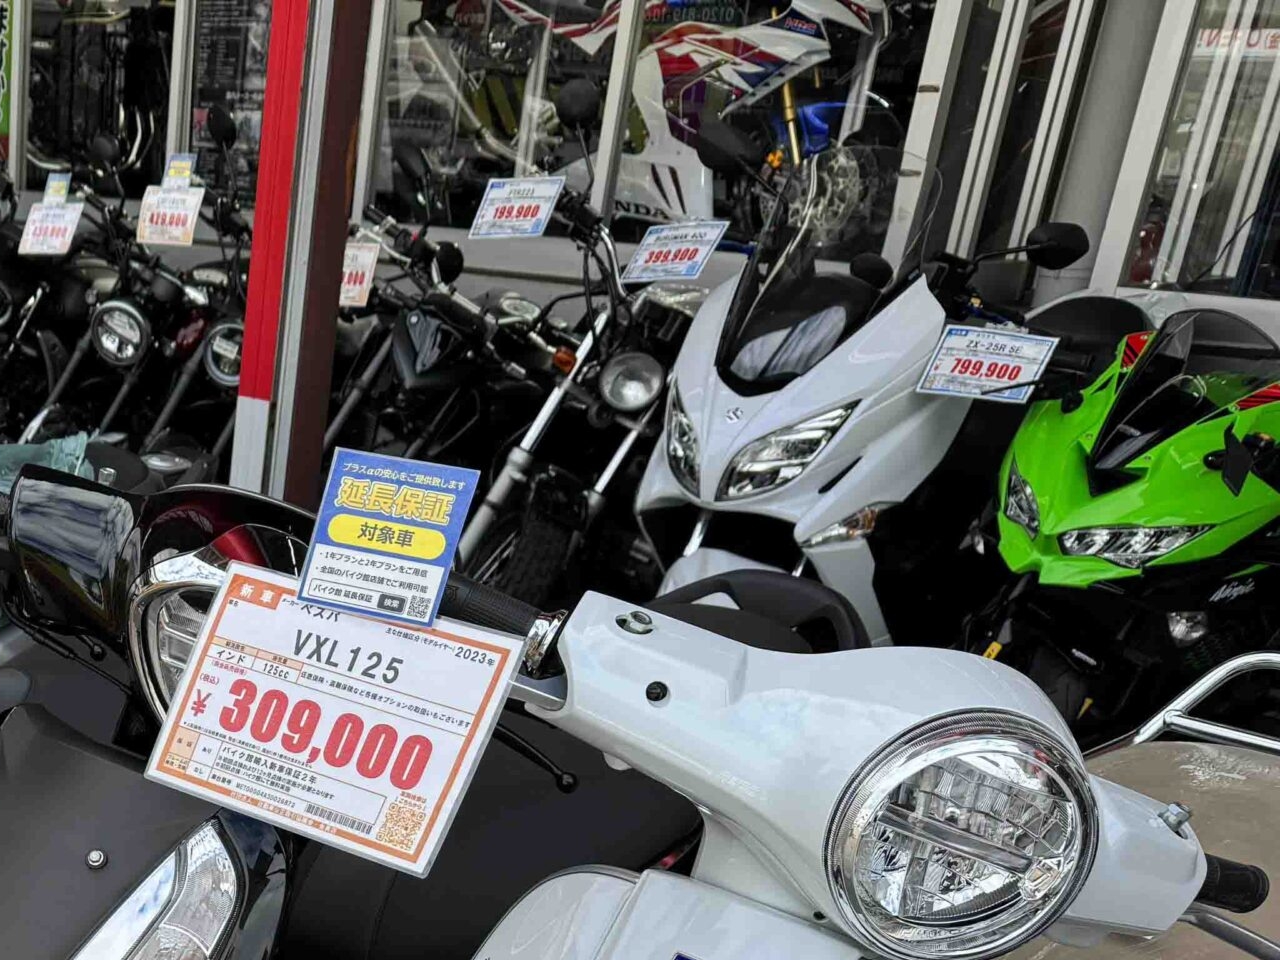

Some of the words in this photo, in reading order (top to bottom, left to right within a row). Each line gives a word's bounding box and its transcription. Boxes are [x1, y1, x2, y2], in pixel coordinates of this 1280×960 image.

[493, 204, 541, 220] 199,900
[644, 247, 700, 264] 399,900
[966, 339, 1007, 352] ZX-25R
[950, 358, 1022, 382] 799,900
[333, 476, 456, 527] 延長保証
[357, 521, 415, 549] 対象車
[238, 583, 275, 604] 新車
[313, 584, 342, 597] バイク館
[216, 649, 246, 664] インド
[293, 629, 405, 684] VXL125
[455, 646, 496, 667] 2023年
[263, 663, 290, 680] 125cc
[191, 689, 212, 717] ¥
[219, 678, 433, 791] 309,000
